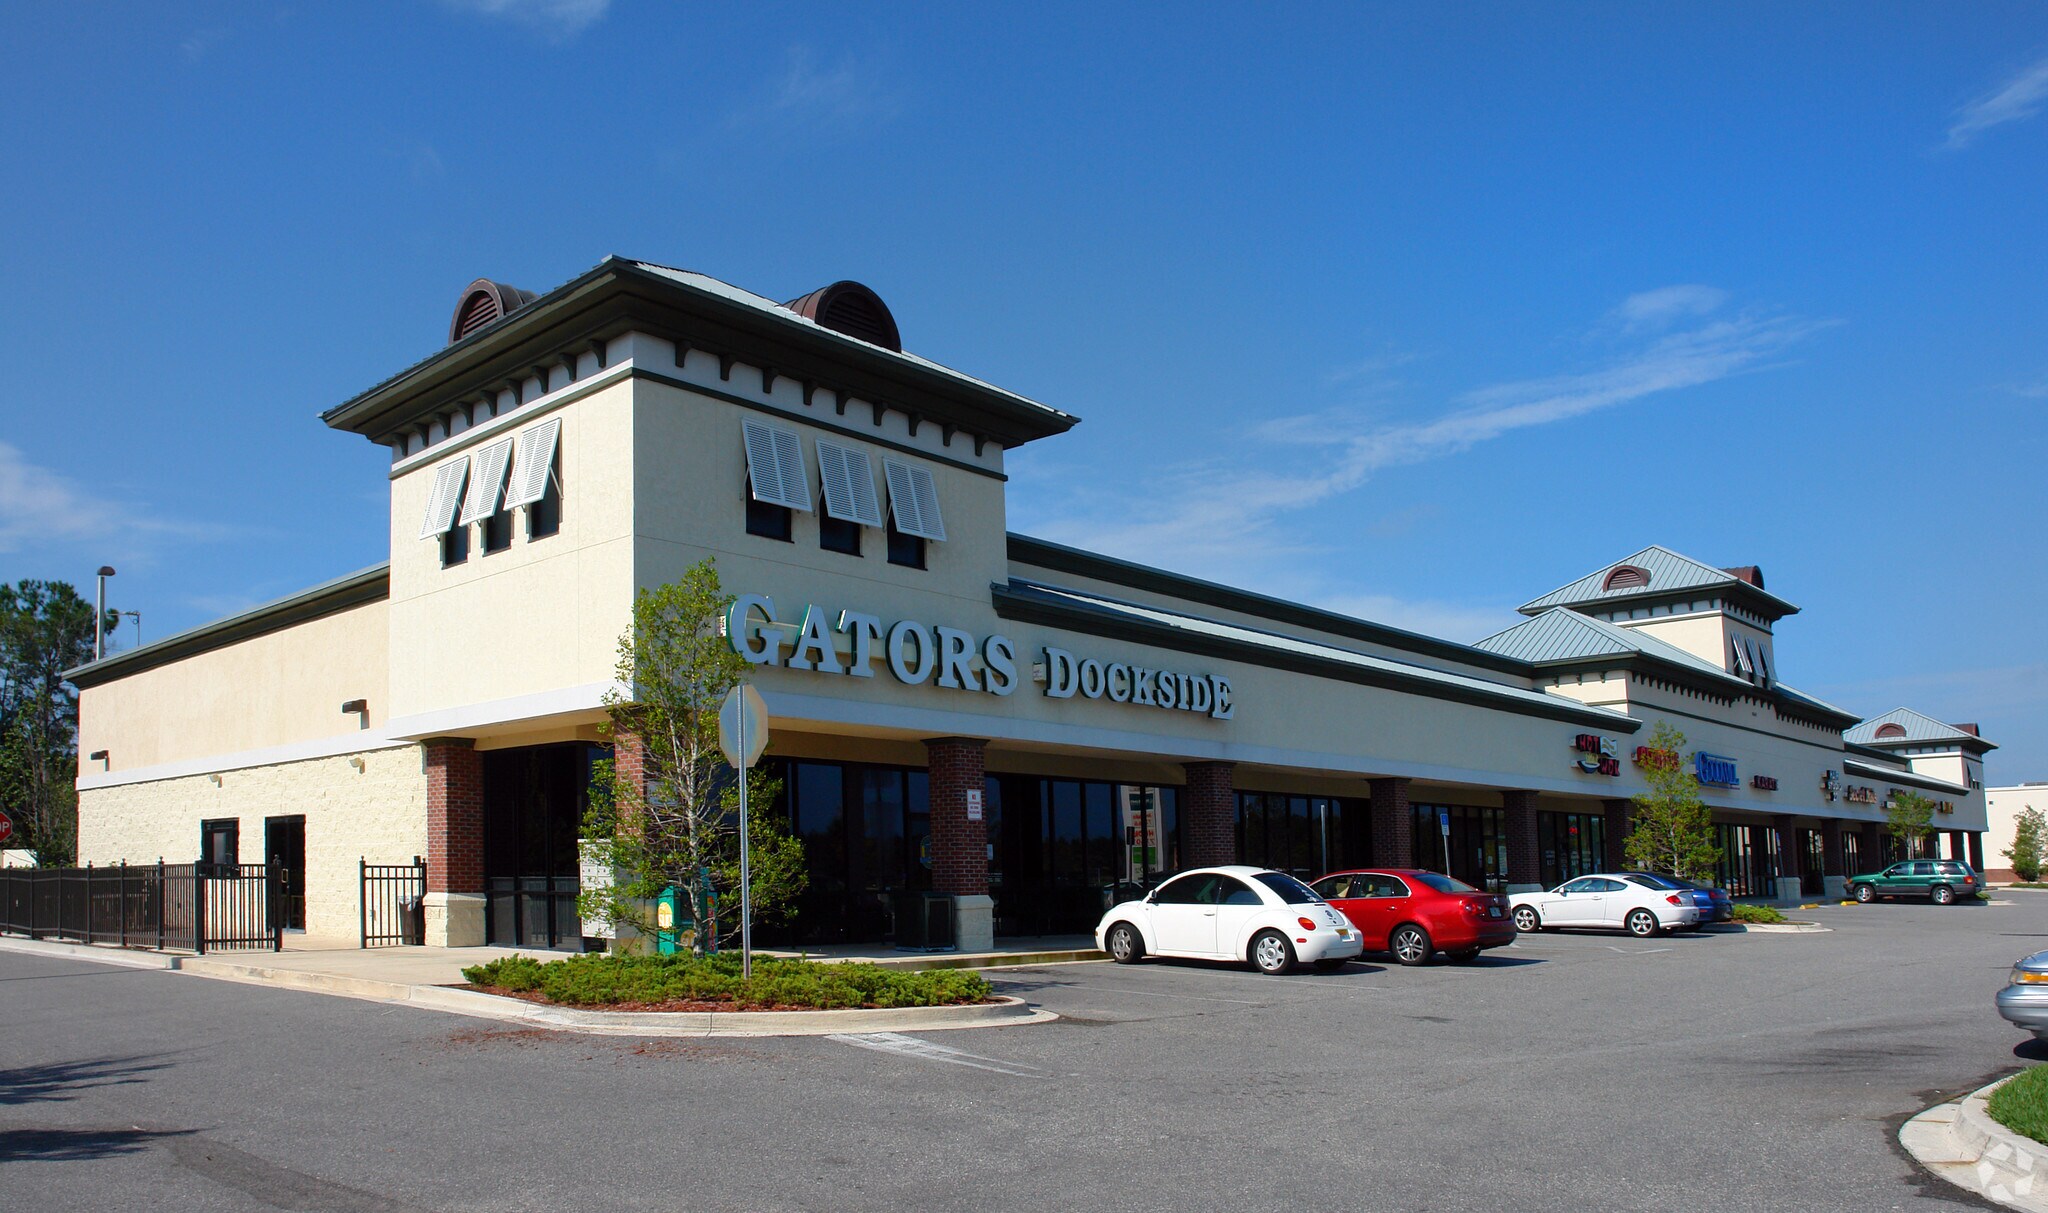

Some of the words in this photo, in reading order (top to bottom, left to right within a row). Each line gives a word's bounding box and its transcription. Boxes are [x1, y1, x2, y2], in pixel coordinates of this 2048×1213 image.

[726, 593, 1018, 697] GATORS
[1043, 646, 1235, 721] DOCKSIDE
[1576, 734, 1600, 754] HOT
[1598, 757, 1620, 776] WOK
[1695, 751, 1740, 786] GOODWILL
